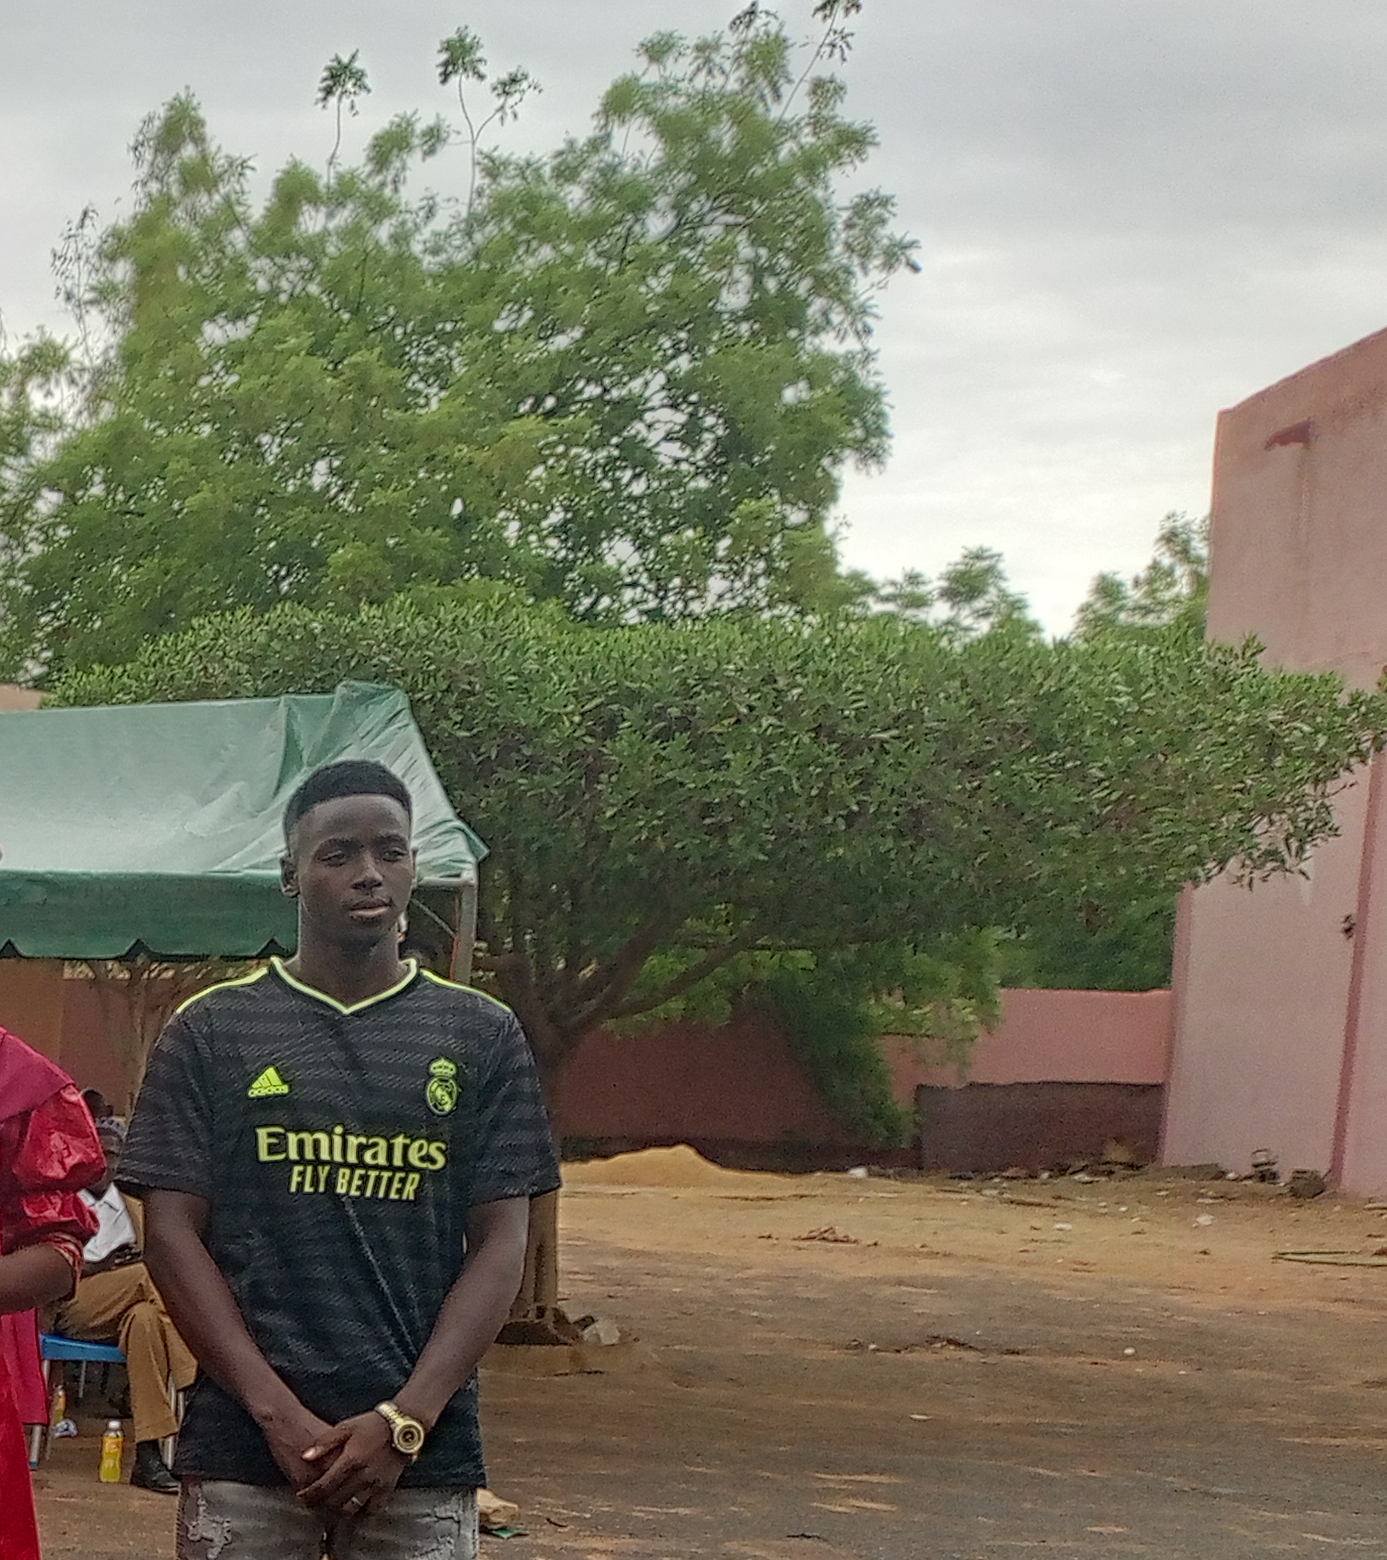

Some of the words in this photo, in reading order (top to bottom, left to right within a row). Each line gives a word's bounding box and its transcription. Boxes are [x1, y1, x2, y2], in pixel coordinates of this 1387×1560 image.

[247, 1084, 290, 1098] adidas
[255, 1124, 448, 1171] Emirates
[289, 1165, 330, 1193] FLY
[335, 1168, 421, 1201] BETTER
